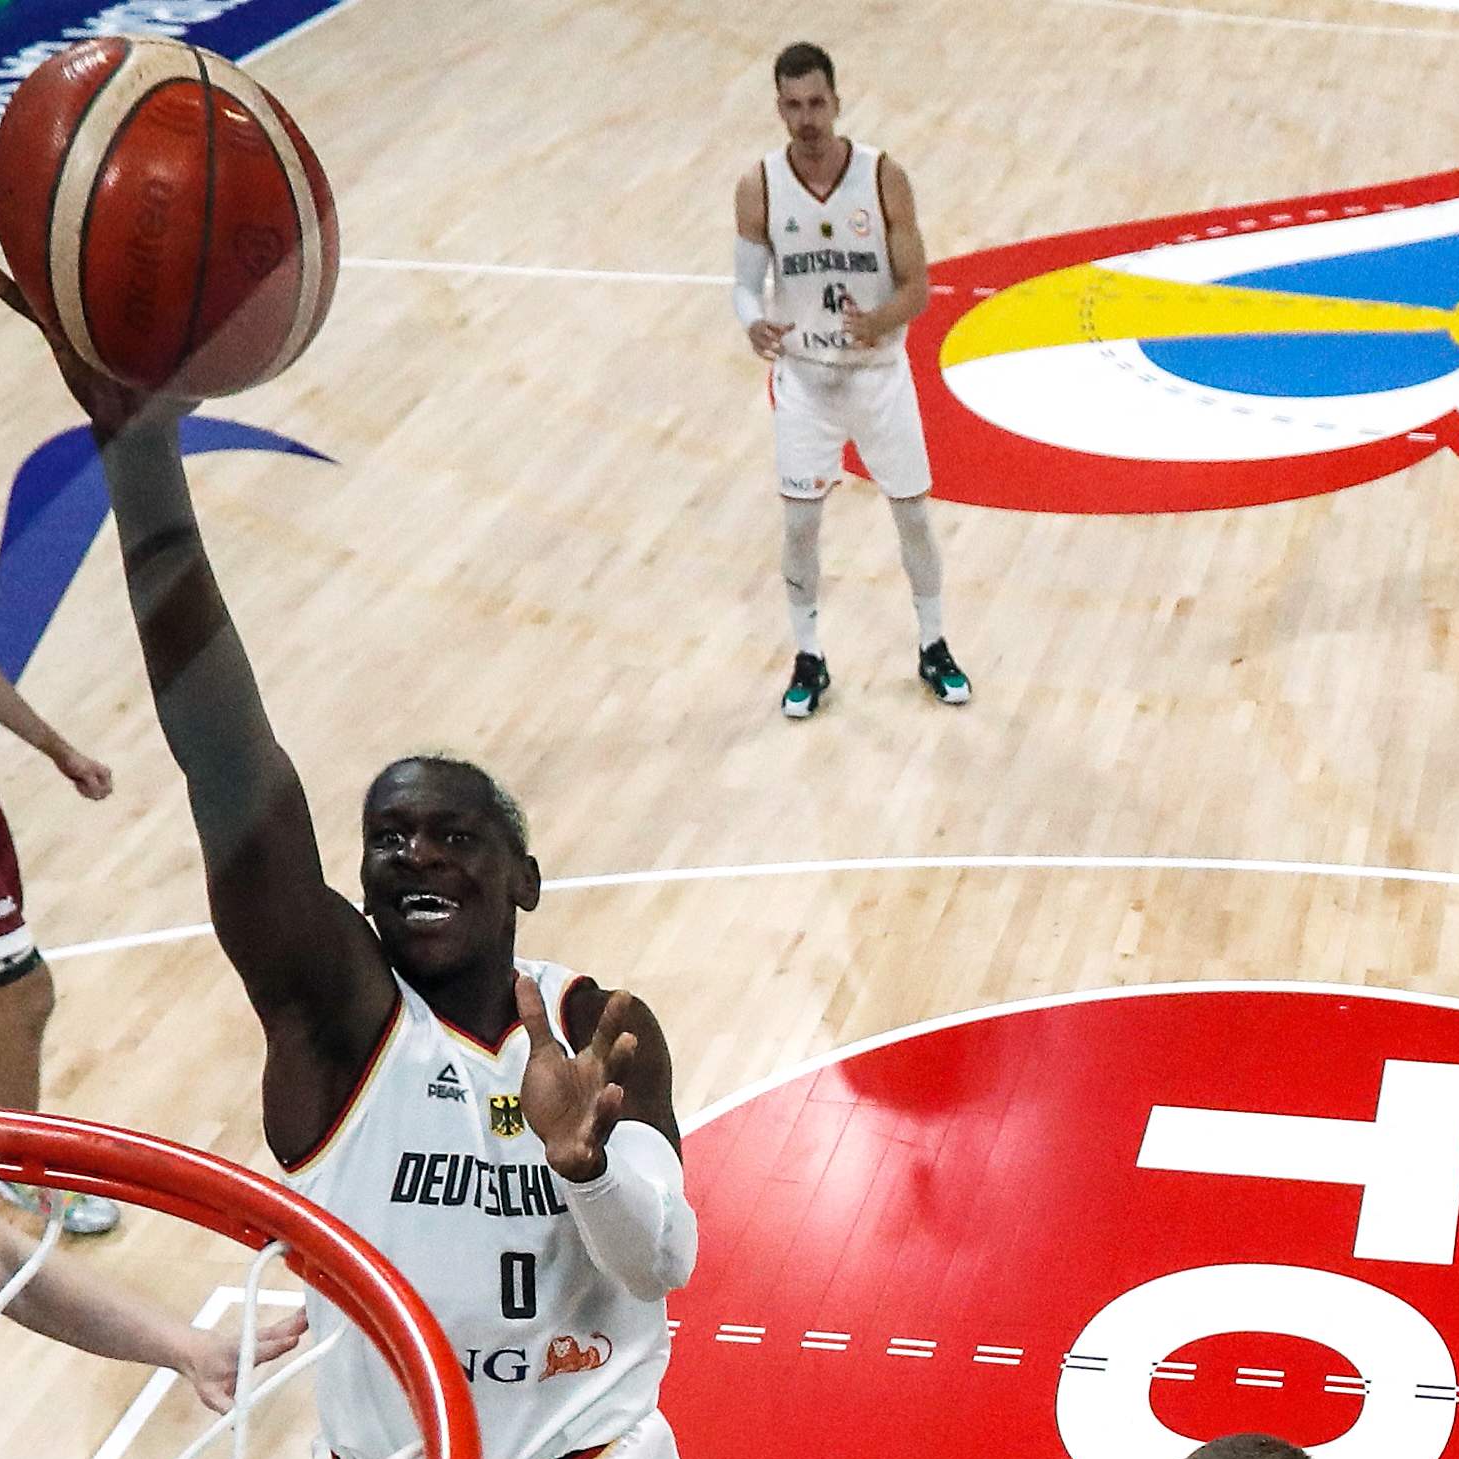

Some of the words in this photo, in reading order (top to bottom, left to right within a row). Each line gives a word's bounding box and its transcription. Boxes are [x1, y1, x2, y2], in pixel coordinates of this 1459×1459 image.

[782, 248, 879, 276] DEUTSCHLAND
[427, 1083, 467, 1104] PEAK
[391, 1152, 568, 1217] DEUTSCHL
[500, 1251, 537, 1320] 0
